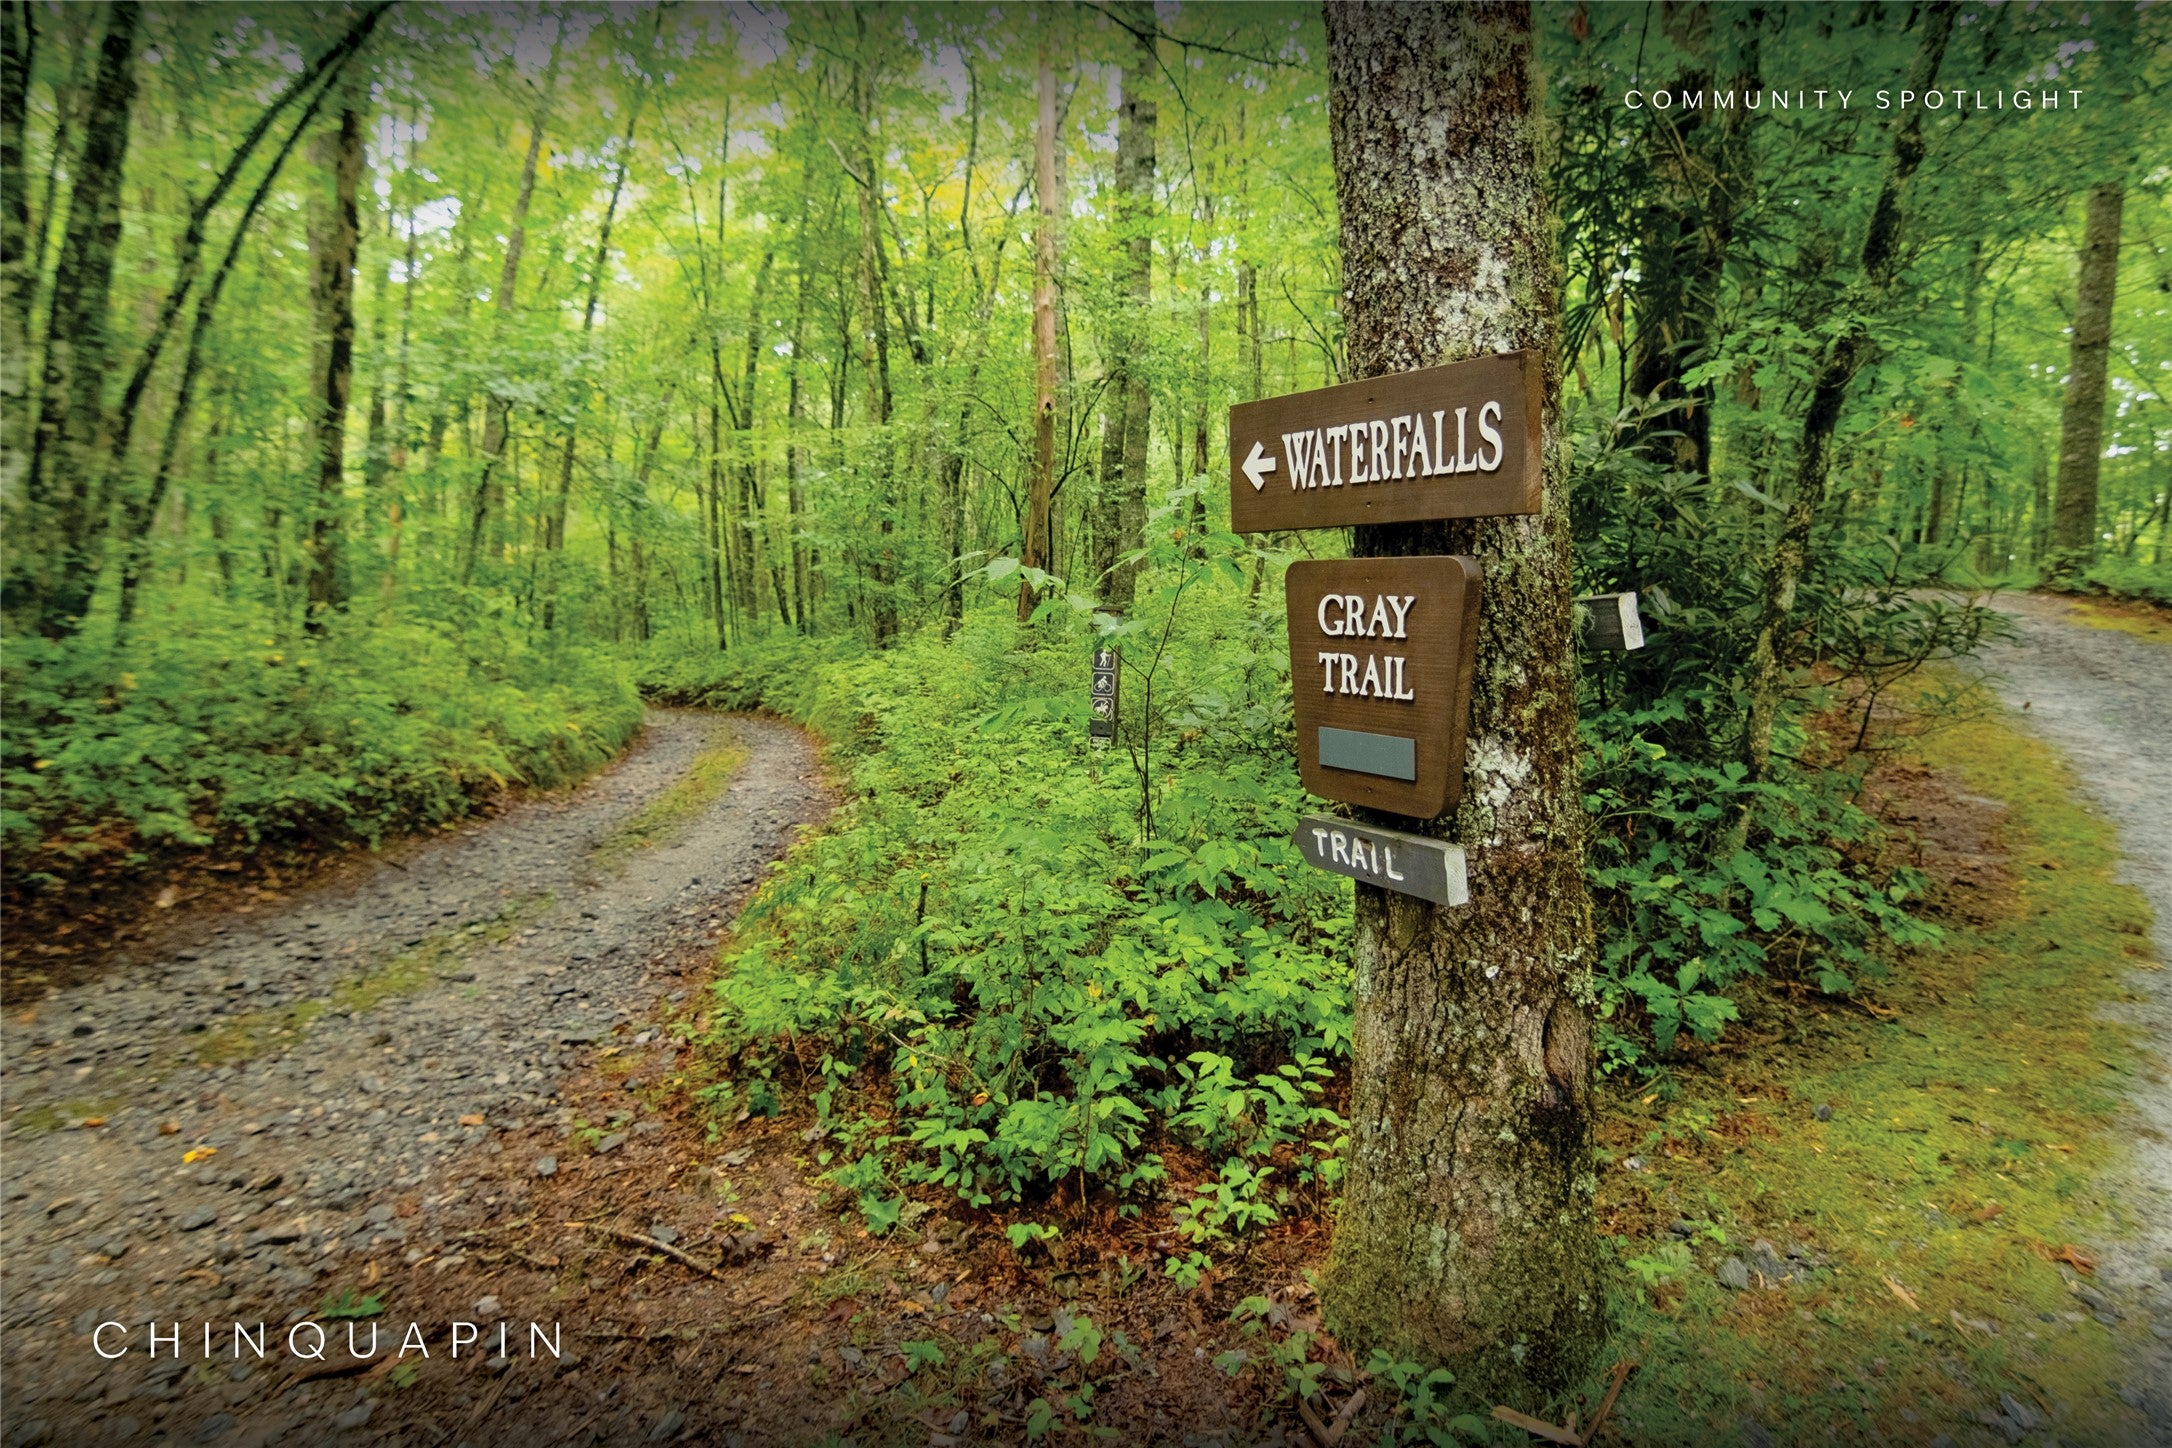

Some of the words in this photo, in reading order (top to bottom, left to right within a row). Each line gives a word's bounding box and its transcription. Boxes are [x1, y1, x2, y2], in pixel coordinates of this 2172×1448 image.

[1282, 400, 1504, 491] WATERFALLS
[1317, 593, 1415, 639] GRAY
[1318, 651, 1415, 701] TRAIL
[1311, 827, 1404, 882] TRAIL
